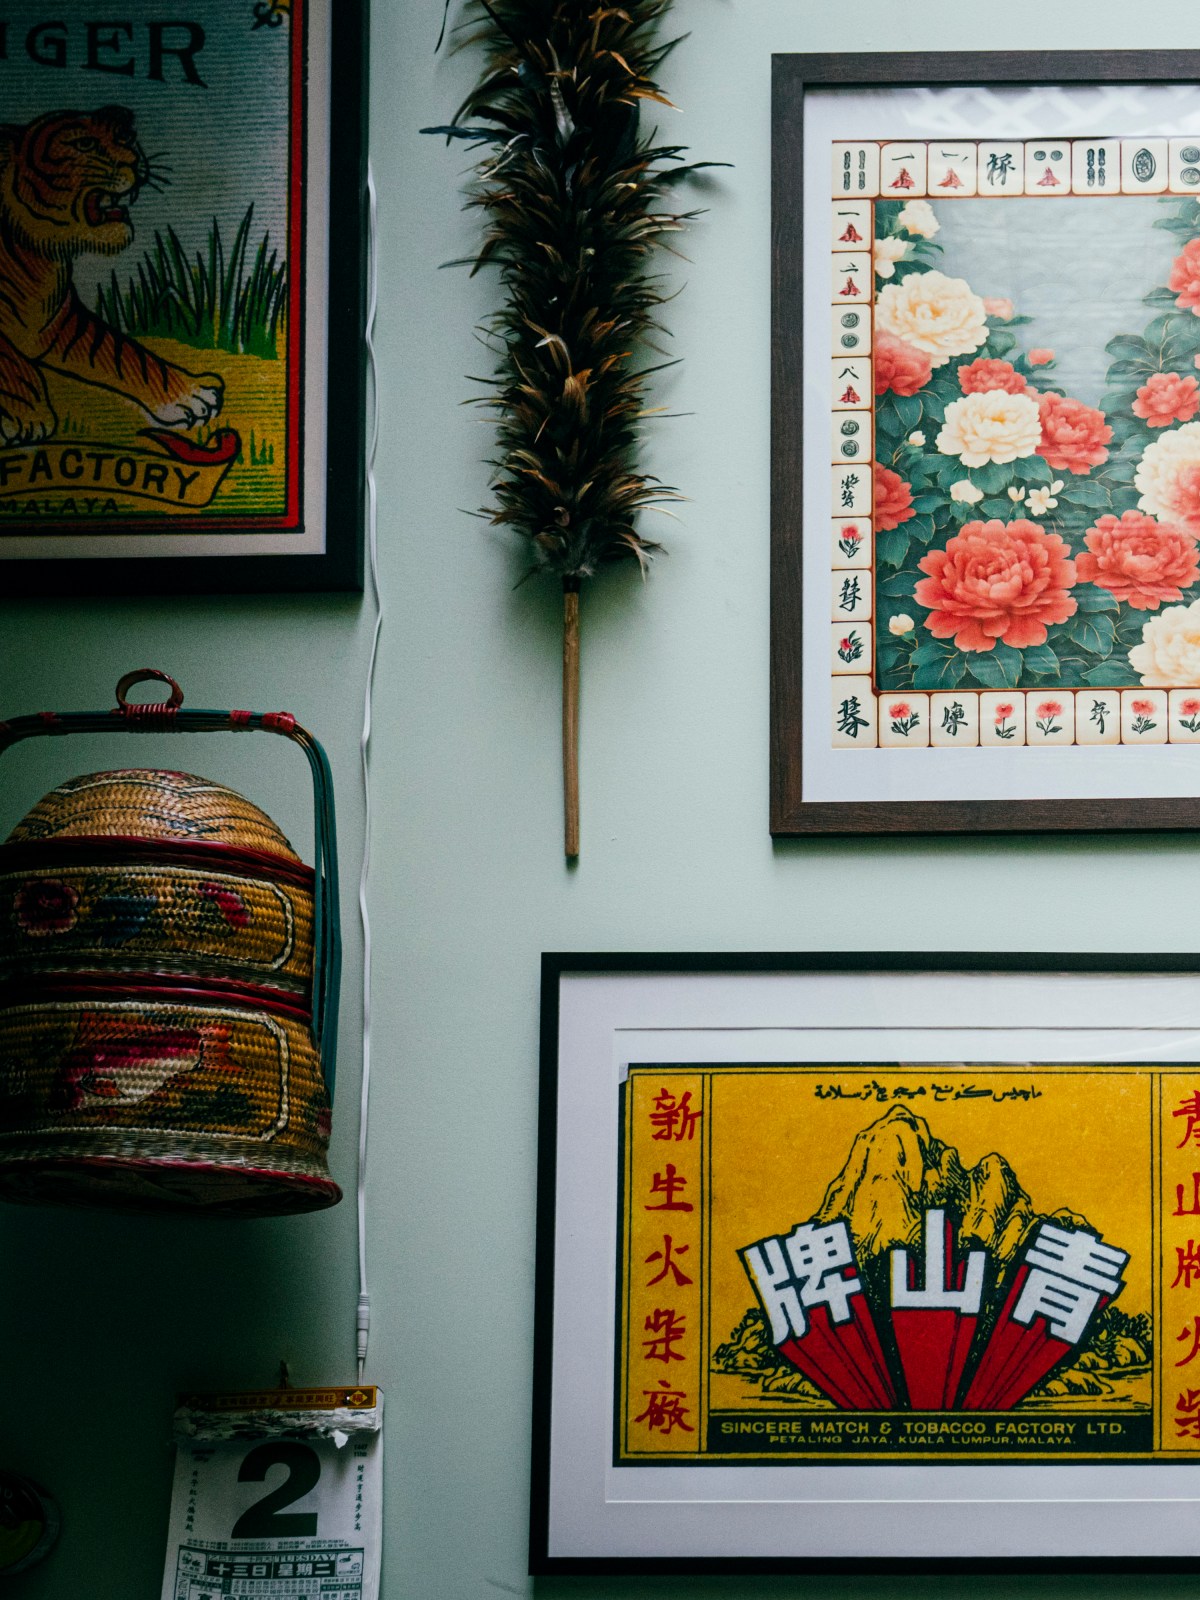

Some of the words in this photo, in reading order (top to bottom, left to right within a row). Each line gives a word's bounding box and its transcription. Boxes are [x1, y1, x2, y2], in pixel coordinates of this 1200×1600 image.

[0, 448, 200, 499] FACTORY
[721, 1421, 802, 1434] SINCERE
[811, 1421, 869, 1434] MATCH
[880, 1421, 892, 1434] &
[903, 1421, 986, 1434] TOBACCO
[995, 1422, 1076, 1434] FACTORY
[1087, 1422, 1126, 1435] LTD.
[769, 1435, 843, 1444] PETALING
[898, 1435, 945, 1444] KUALA
[231, 1441, 321, 1539] 2
[275, 1554, 335, 1562] TUESDAY
[212, 1563, 267, 1576] 十三日
[278, 1563, 331, 1576] 星期二
